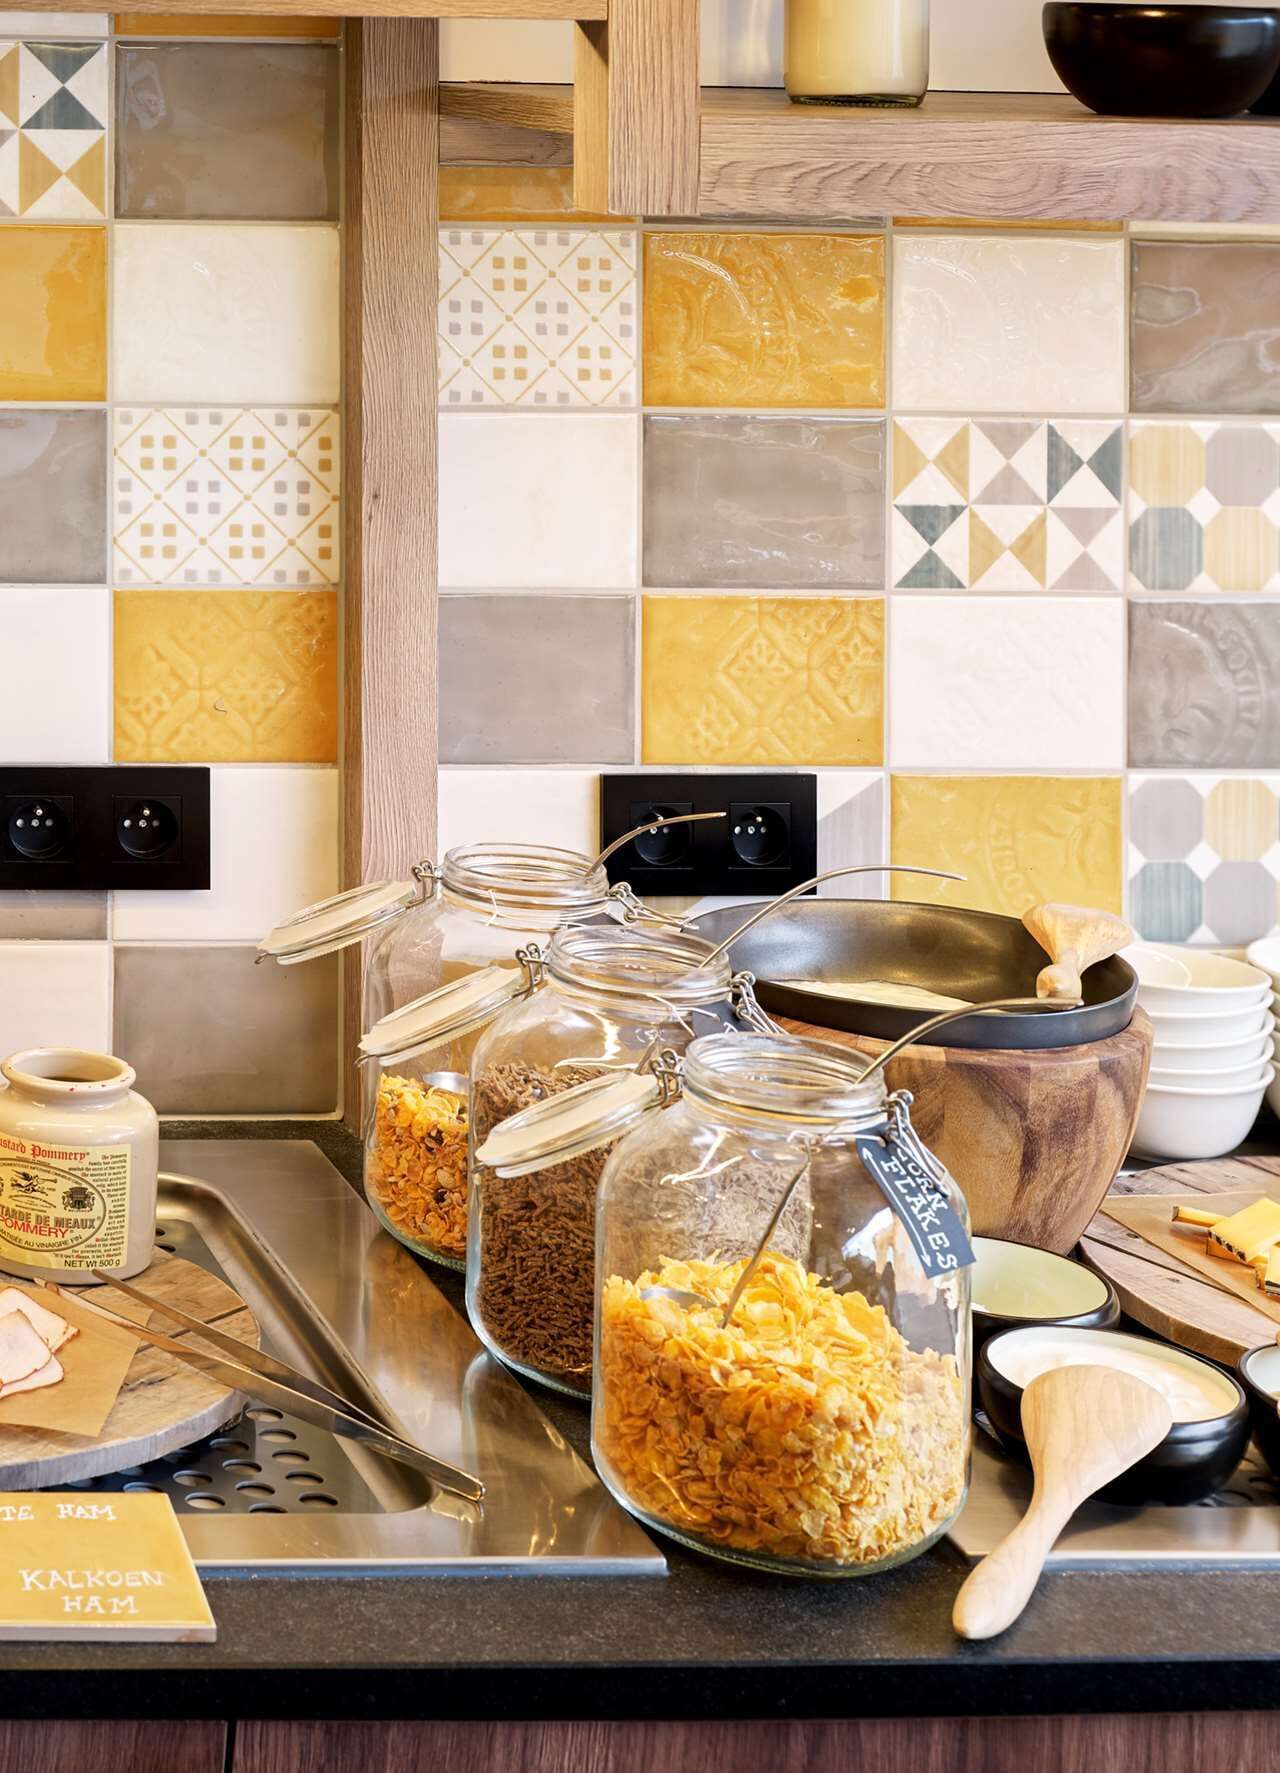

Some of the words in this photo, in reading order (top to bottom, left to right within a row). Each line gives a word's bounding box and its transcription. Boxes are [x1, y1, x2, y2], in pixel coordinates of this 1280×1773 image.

[35, 1214, 50, 1227] DE
[880, 1155, 958, 1270] FLAKES
[24, 1240, 35, 1248] AU
[36, 1239, 68, 1248] VINAIGRE
[64, 1259, 83, 1267] NET
[86, 1260, 97, 1268] Wt
[99, 1258, 113, 1267] 500
[20, 1569, 166, 1591] KALKOEN
[63, 1595, 140, 1615] HAM
